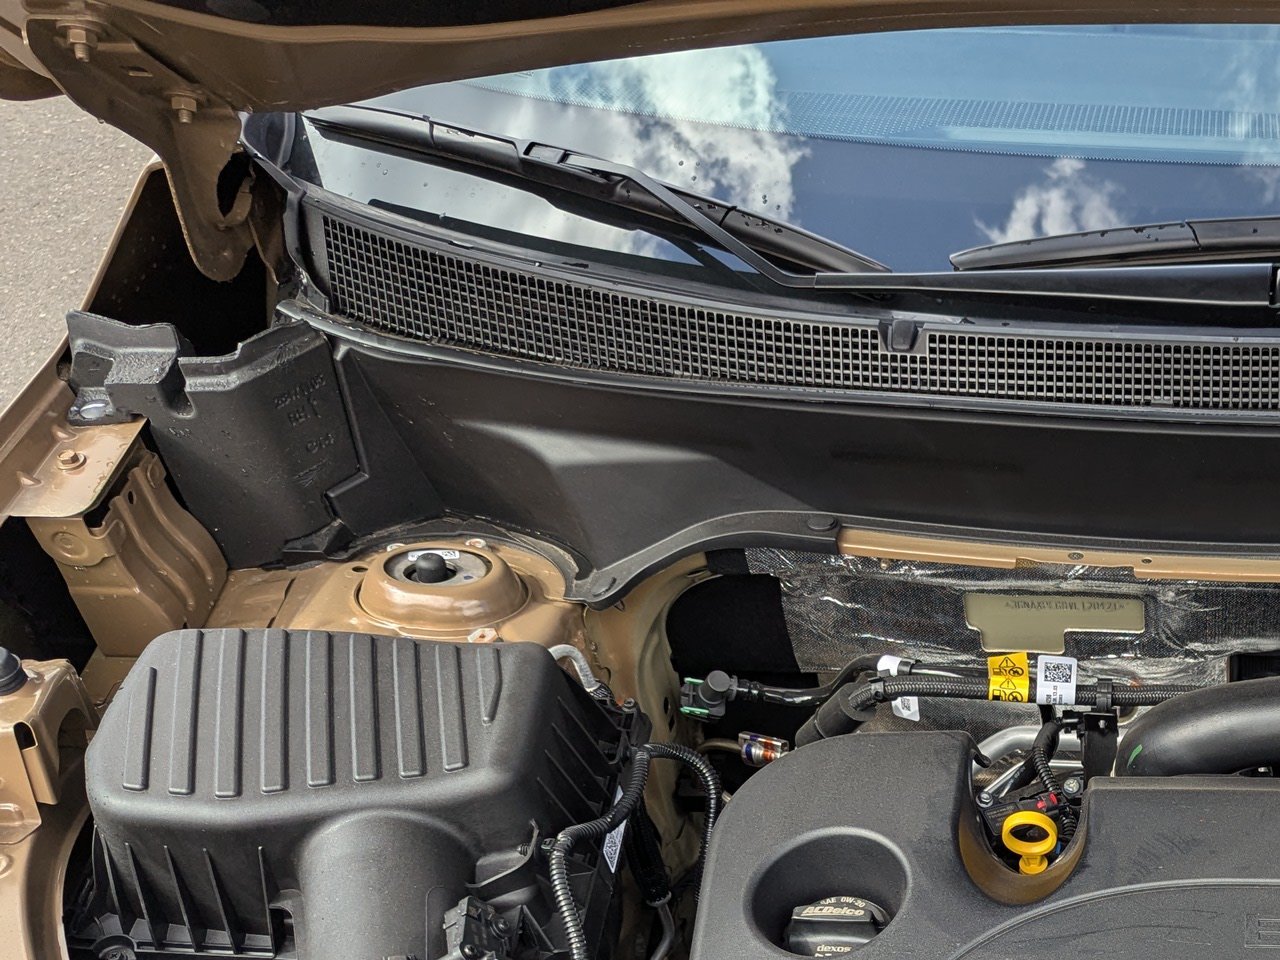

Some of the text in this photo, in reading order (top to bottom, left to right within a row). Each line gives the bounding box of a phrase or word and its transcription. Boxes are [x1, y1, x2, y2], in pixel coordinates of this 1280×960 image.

[820, 896, 866, 908] SAE 0W-20
[800, 906, 865, 916] ACDelco
[816, 944, 852, 953] dexos
